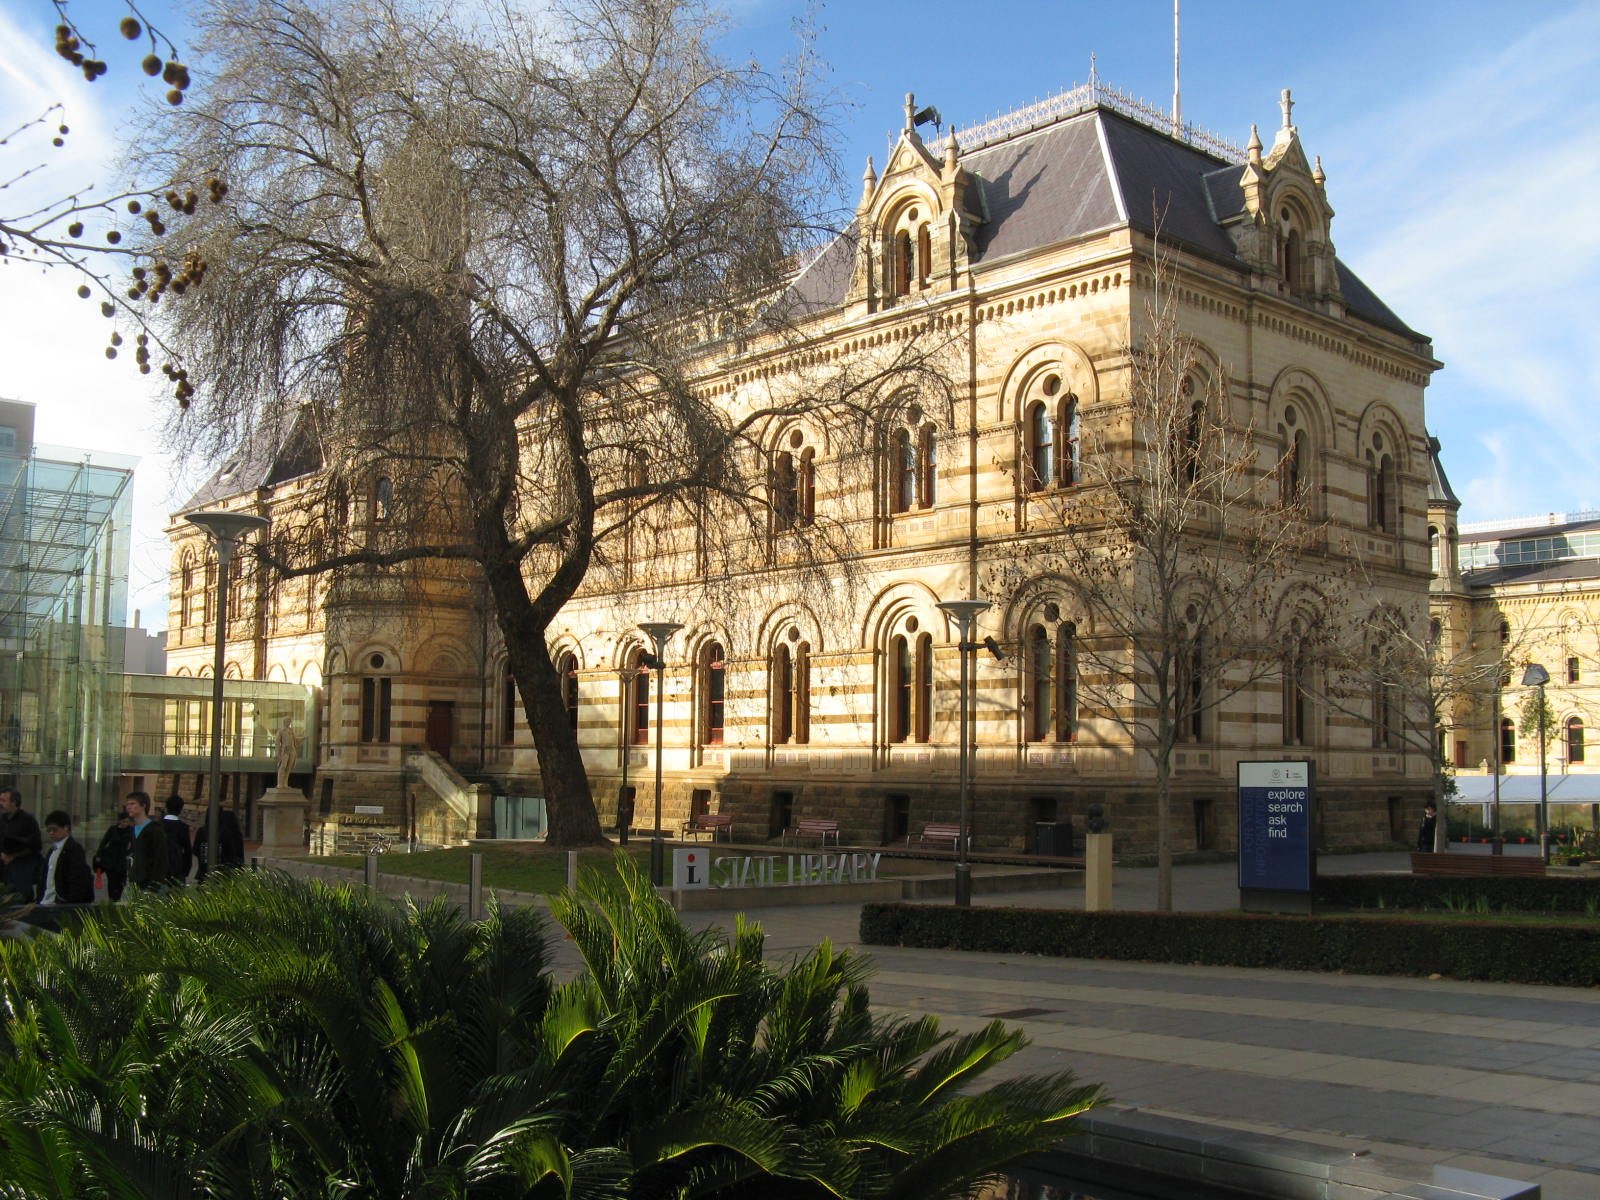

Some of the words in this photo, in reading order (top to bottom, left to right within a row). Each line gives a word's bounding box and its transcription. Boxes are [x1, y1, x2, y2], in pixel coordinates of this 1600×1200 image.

[1267, 788, 1305, 801] explore
[1268, 802, 1303, 812] search
[1268, 815, 1287, 825] ask
[1268, 827, 1287, 838] find
[714, 856, 782, 889] STATE
[787, 853, 881, 887] LIBRARY
